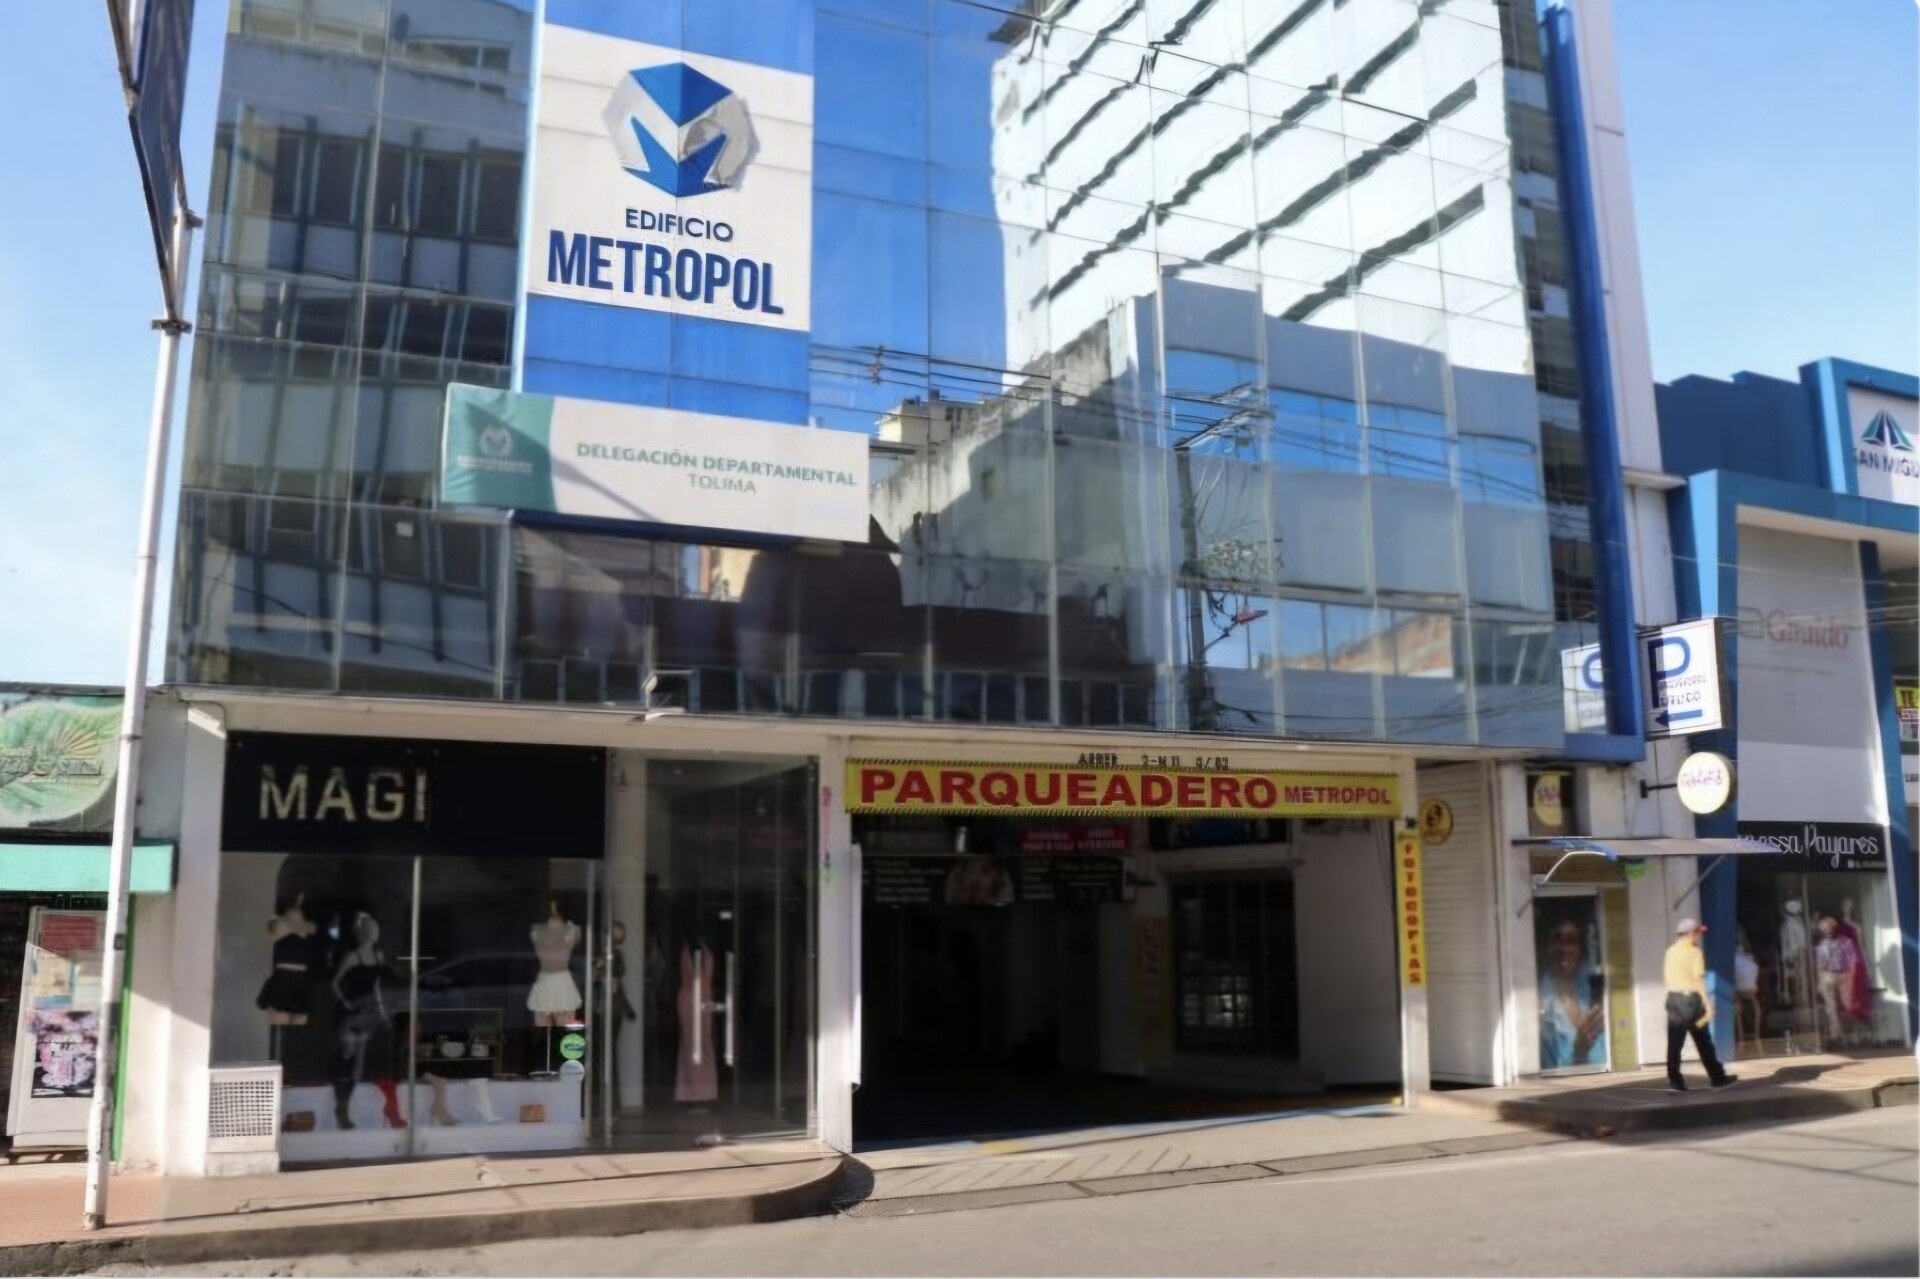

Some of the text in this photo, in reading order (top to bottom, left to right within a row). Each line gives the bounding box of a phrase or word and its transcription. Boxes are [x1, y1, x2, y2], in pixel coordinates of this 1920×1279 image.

[625, 207, 735, 243] EDIFICIO
[547, 229, 785, 315] METROPOL
[577, 441, 858, 487] DELEGACIÓN DEPARTAMENTAL
[687, 473, 757, 495] TOLIMA
[259, 764, 428, 823] MAGI
[861, 768, 1392, 810] PARQUEADERO METROPOL
